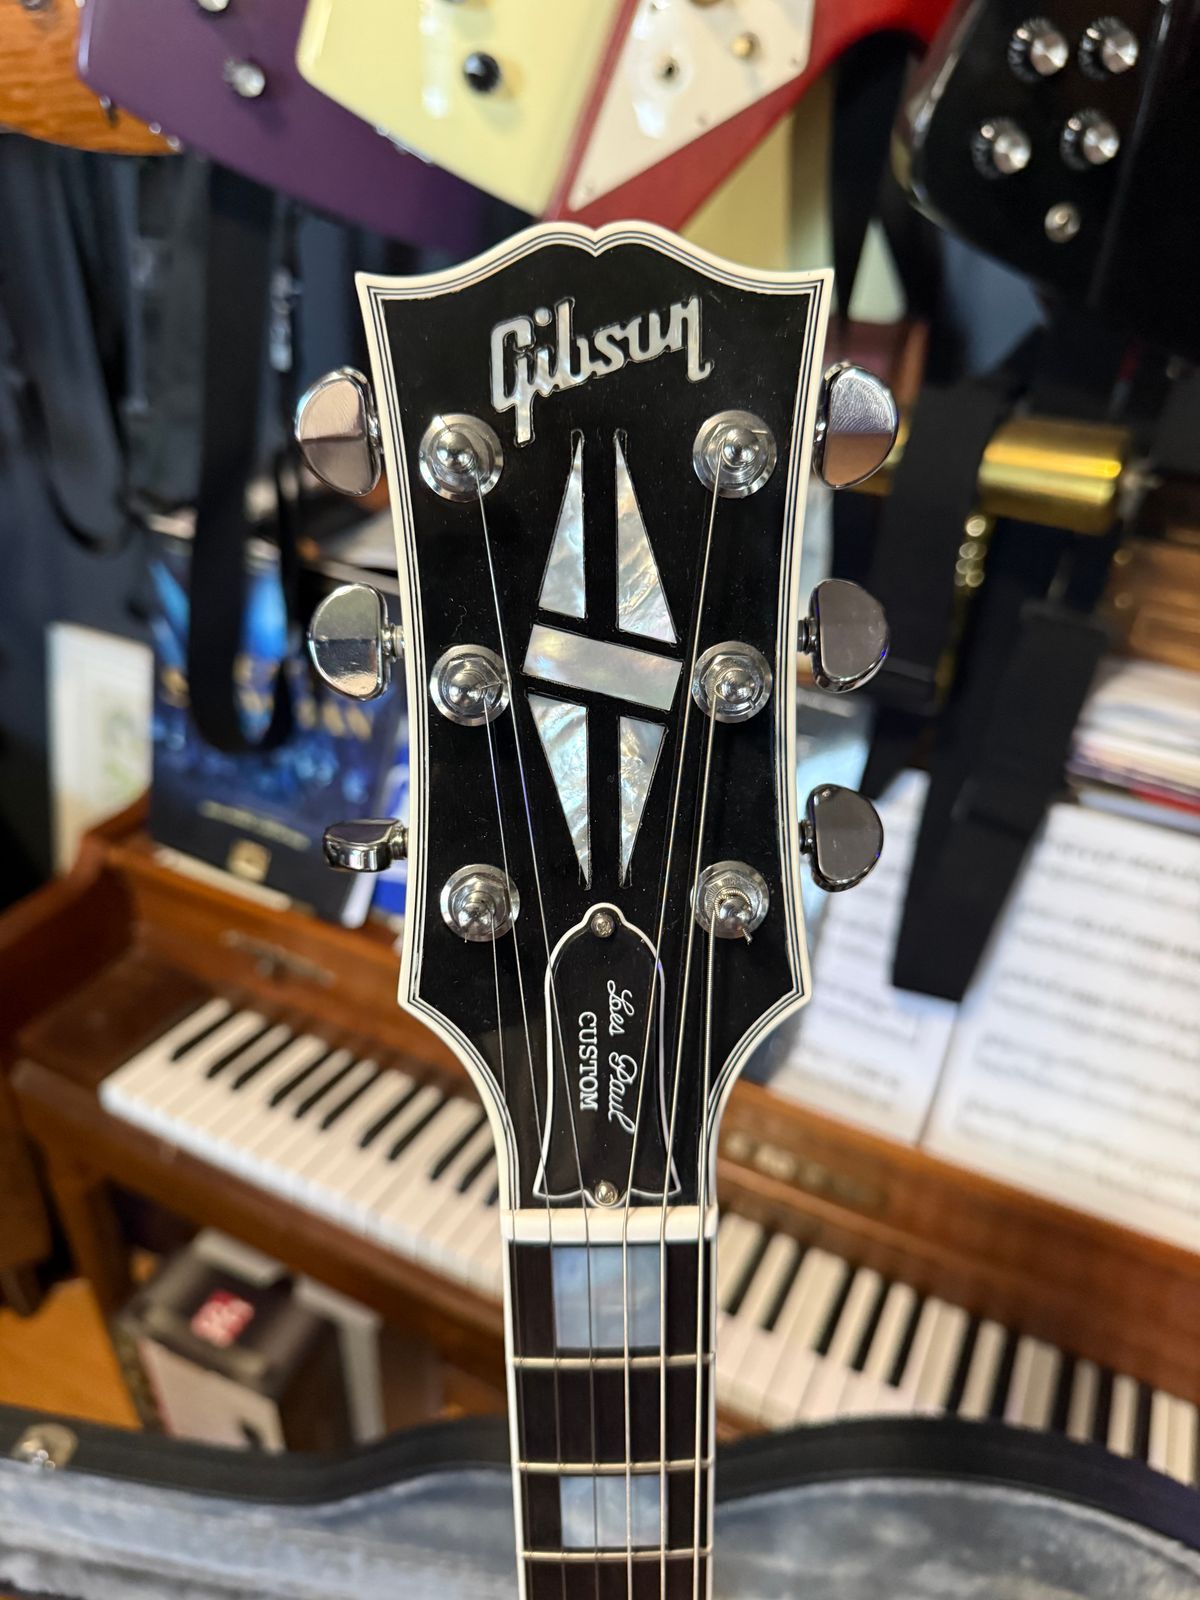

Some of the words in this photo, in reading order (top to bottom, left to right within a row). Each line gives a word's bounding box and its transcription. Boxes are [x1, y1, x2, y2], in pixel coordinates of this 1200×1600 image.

[490, 297, 713, 445] Gibson
[606, 979, 635, 1036] Les
[578, 1011, 599, 1112] CUSTOM
[608, 1051, 638, 1135] Paul
